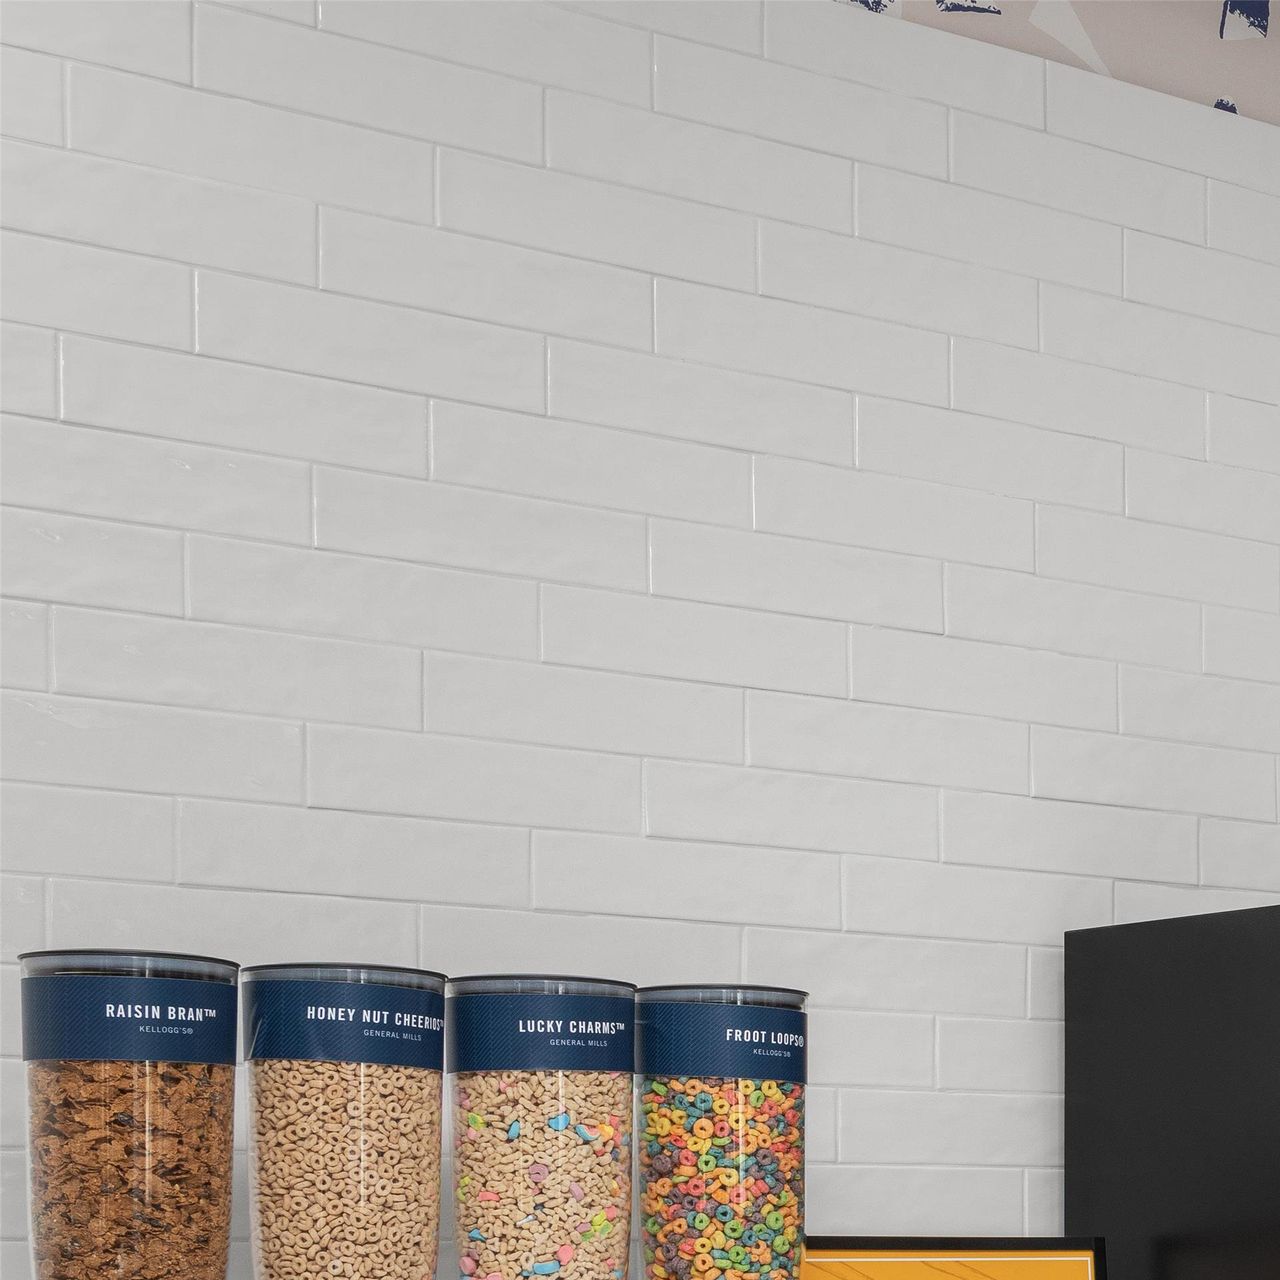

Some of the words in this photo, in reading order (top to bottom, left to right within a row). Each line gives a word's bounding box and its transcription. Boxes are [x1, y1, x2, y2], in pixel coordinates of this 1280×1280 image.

[106, 1004, 160, 1019] RAISIN
[307, 1006, 356, 1022] HONEY
[362, 1009, 389, 1024] NUT
[519, 1020, 563, 1033] LUCKY
[363, 1029, 399, 1039] GENERAL
[402, 1033, 422, 1041] MILLS
[726, 1029, 766, 1043] FROOT
